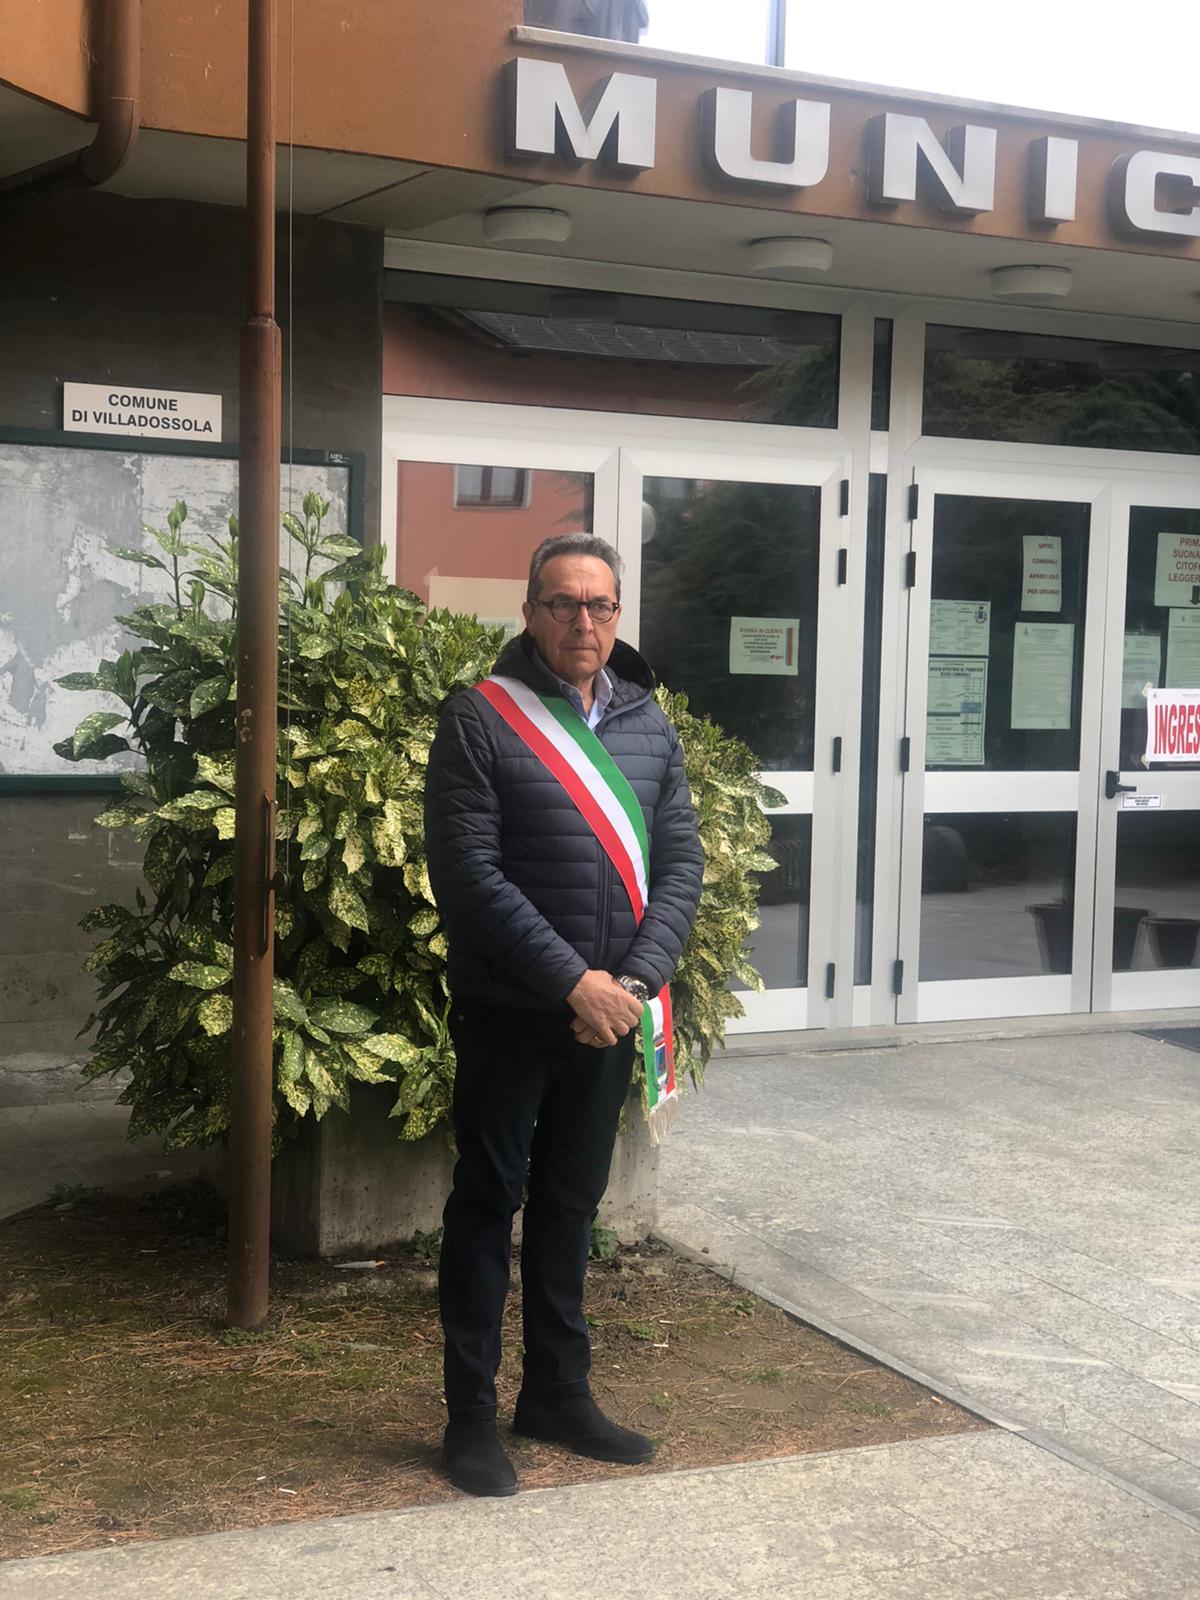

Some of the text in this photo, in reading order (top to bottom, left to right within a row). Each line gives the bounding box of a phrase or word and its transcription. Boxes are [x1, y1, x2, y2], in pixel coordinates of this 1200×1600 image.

[513, 57, 1200, 237] MUNIC
[108, 393, 178, 411] COMUNE
[71, 409, 213, 433] DI VILLADOSSOLA
